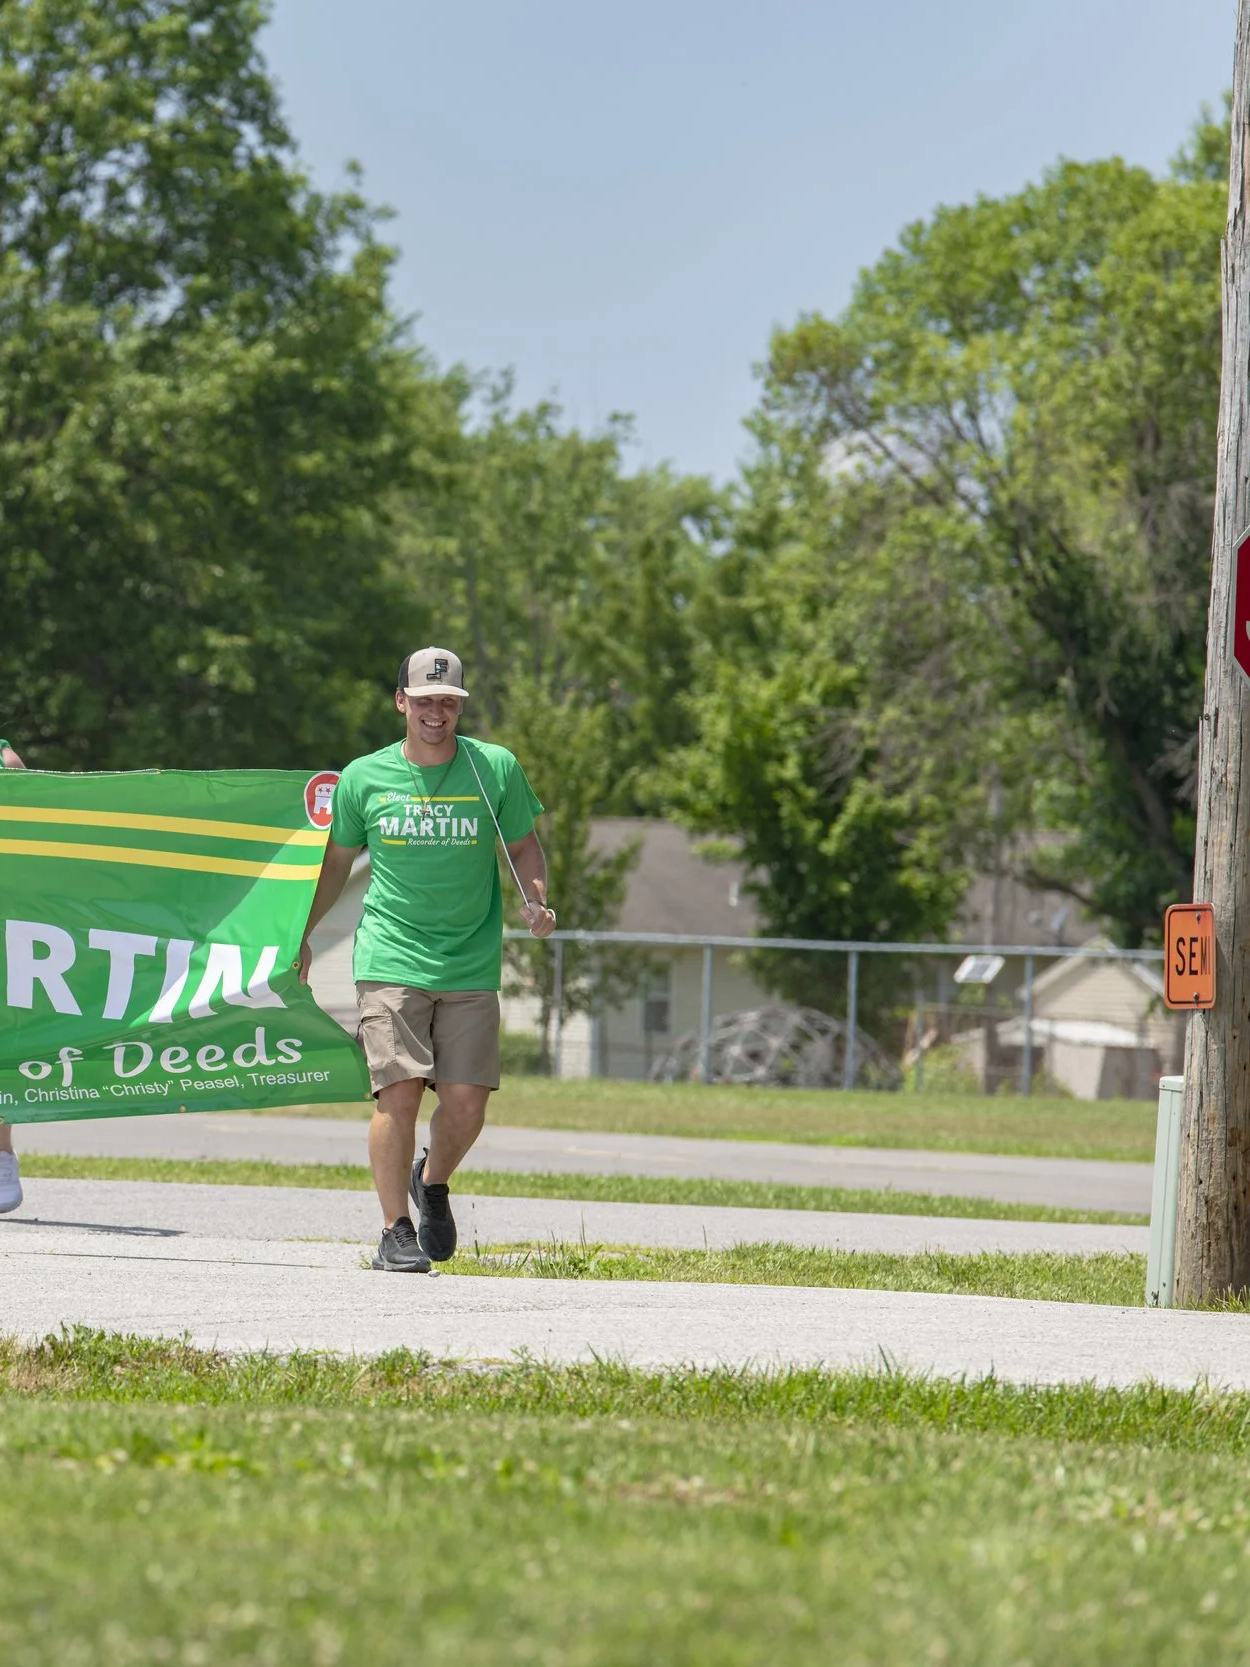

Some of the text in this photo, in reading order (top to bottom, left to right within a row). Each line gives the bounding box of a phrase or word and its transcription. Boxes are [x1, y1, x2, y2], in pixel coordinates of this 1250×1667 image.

[386, 791, 411, 803] Elect
[403, 804, 455, 818] TRACY
[378, 816, 479, 838] MARTIN
[407, 837, 471, 847] Recorder of Deeds
[18, 1047, 85, 1088] of
[102, 1026, 303, 1078] Deeds
[25, 1086, 100, 1103] Christina
[103, 1080, 174, 1097] “Christy”
[180, 1075, 245, 1092] Peasel,
[247, 1070, 330, 1087] Treasurer
